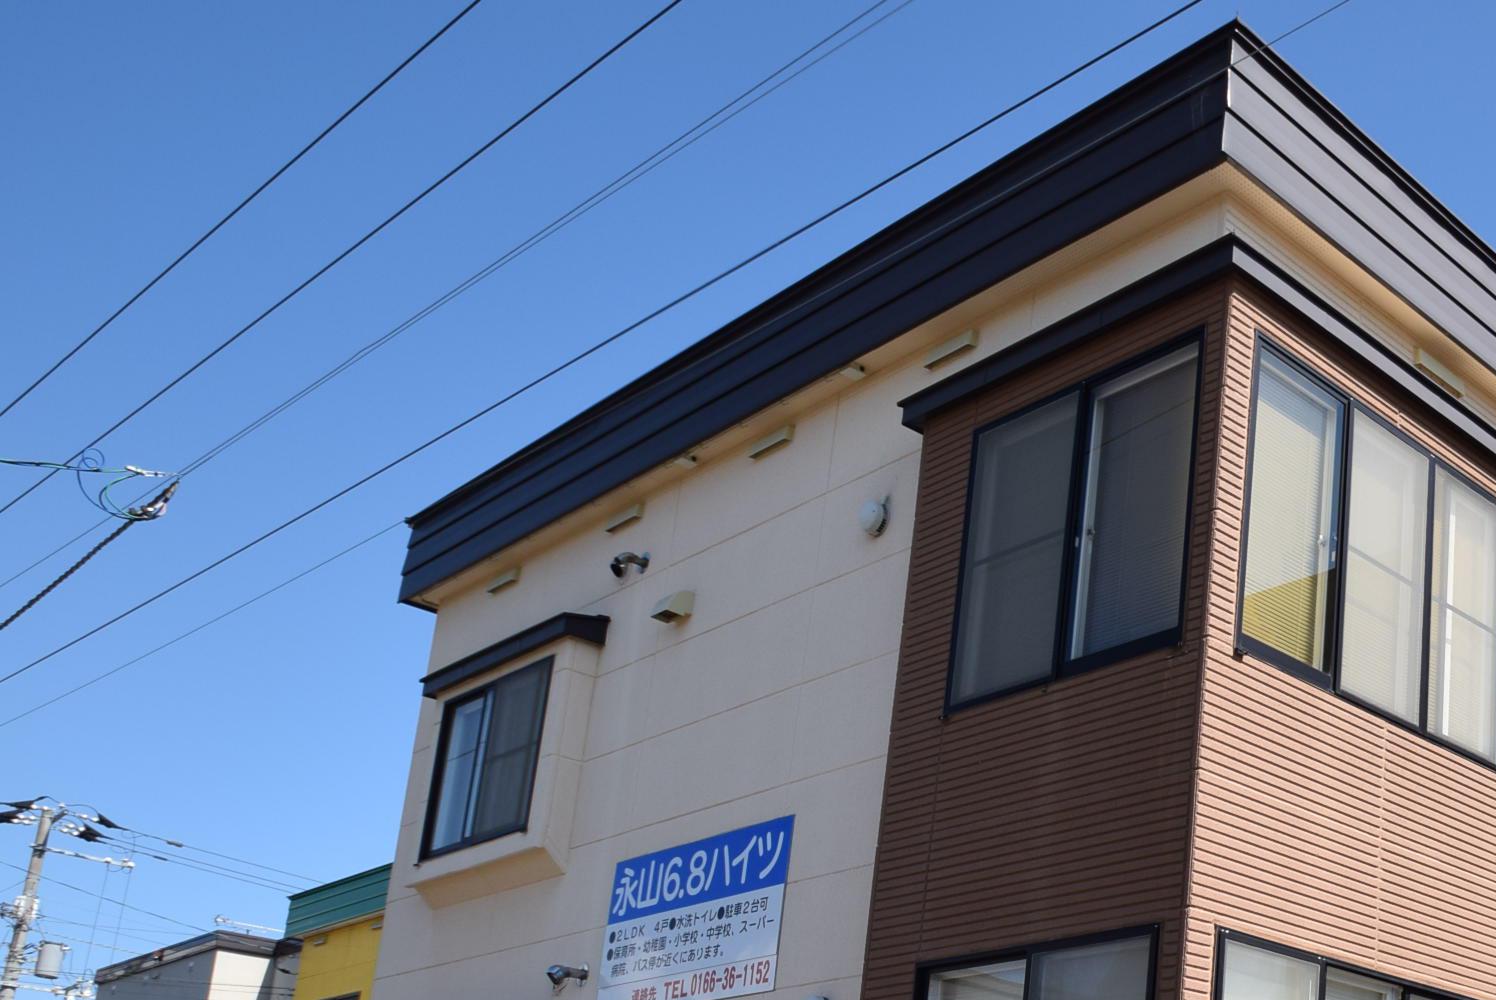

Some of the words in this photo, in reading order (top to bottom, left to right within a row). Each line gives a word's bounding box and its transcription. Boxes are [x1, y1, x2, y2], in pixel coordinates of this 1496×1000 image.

[612, 831, 785, 917] 永山6.8ハイツ
